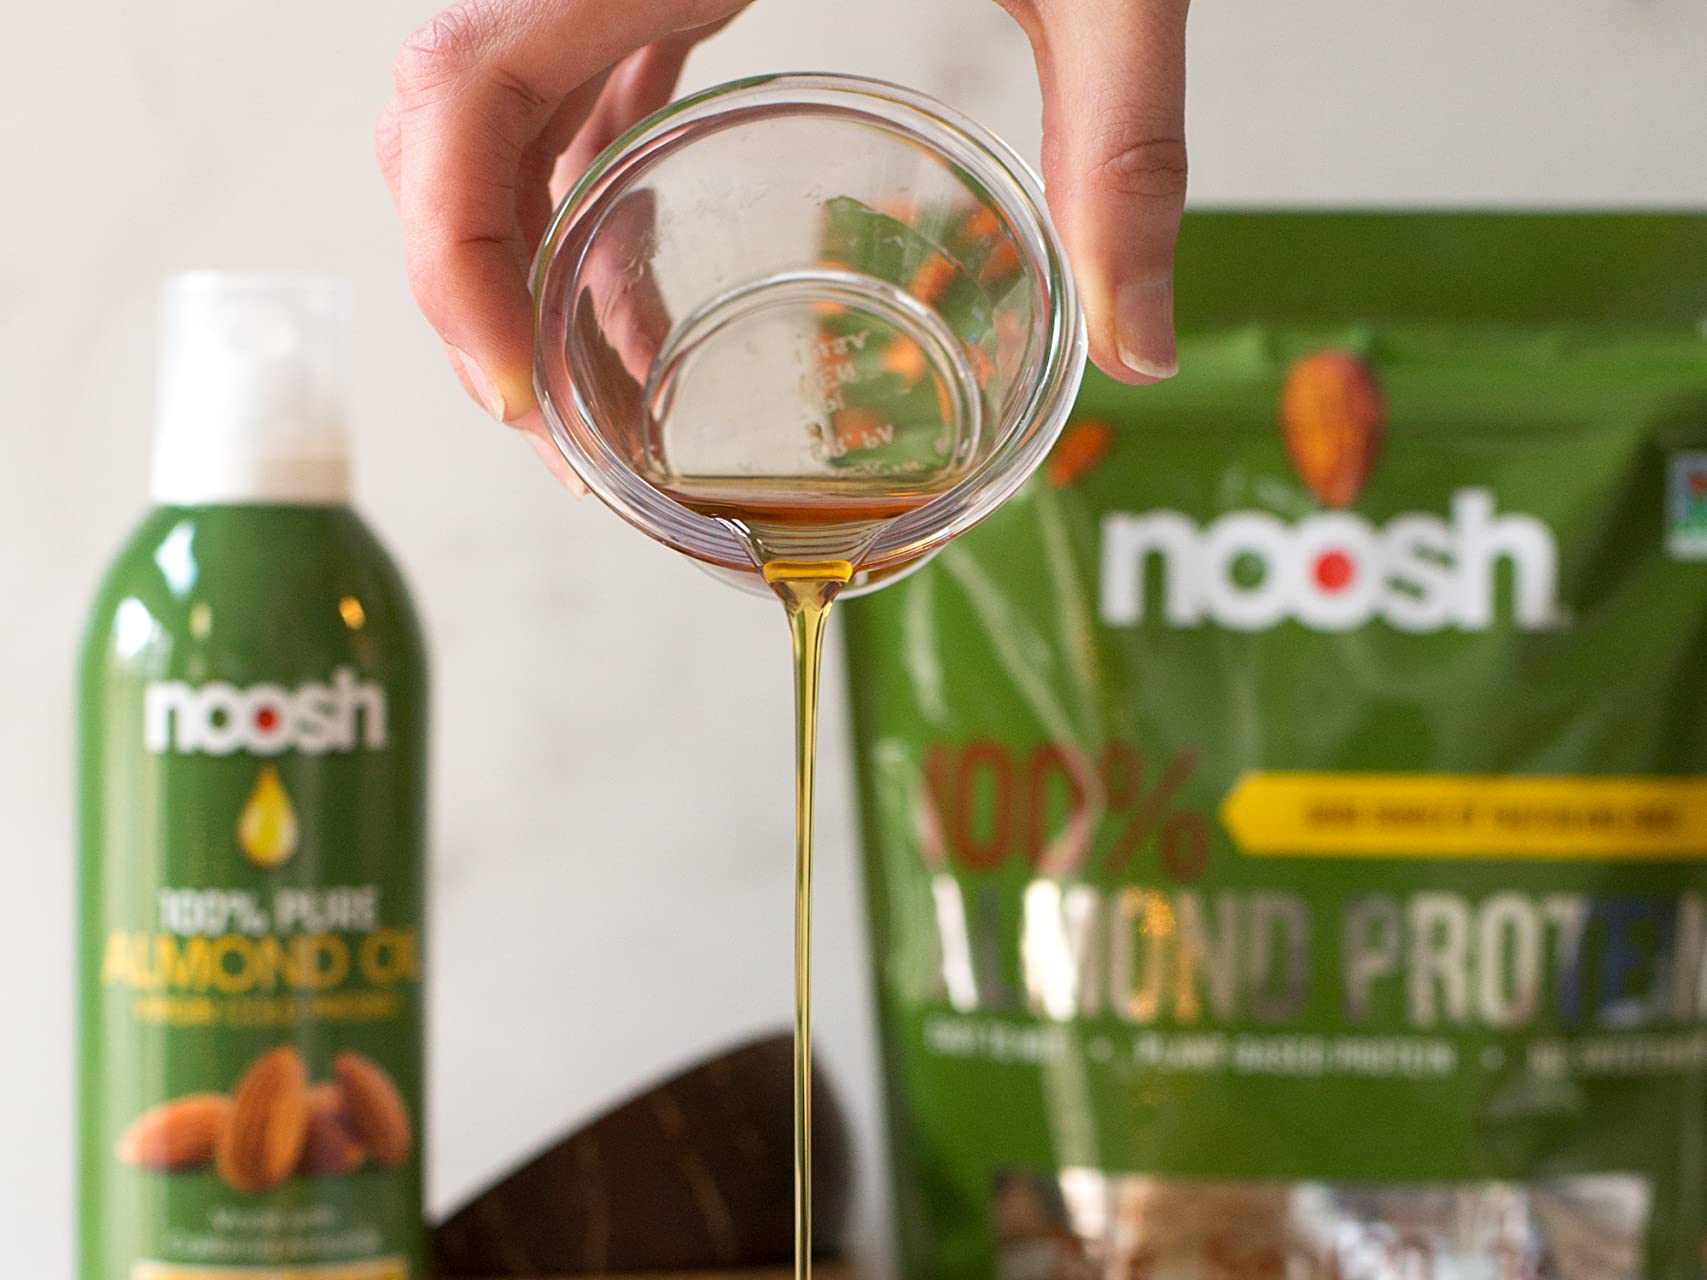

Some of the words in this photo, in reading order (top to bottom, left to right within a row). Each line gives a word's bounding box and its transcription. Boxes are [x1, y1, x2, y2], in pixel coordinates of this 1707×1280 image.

[1102, 487, 1559, 634] noosh
[144, 667, 388, 756] noosh
[924, 738, 1212, 883] 100%
[103, 929, 351, 993] ALMOND
